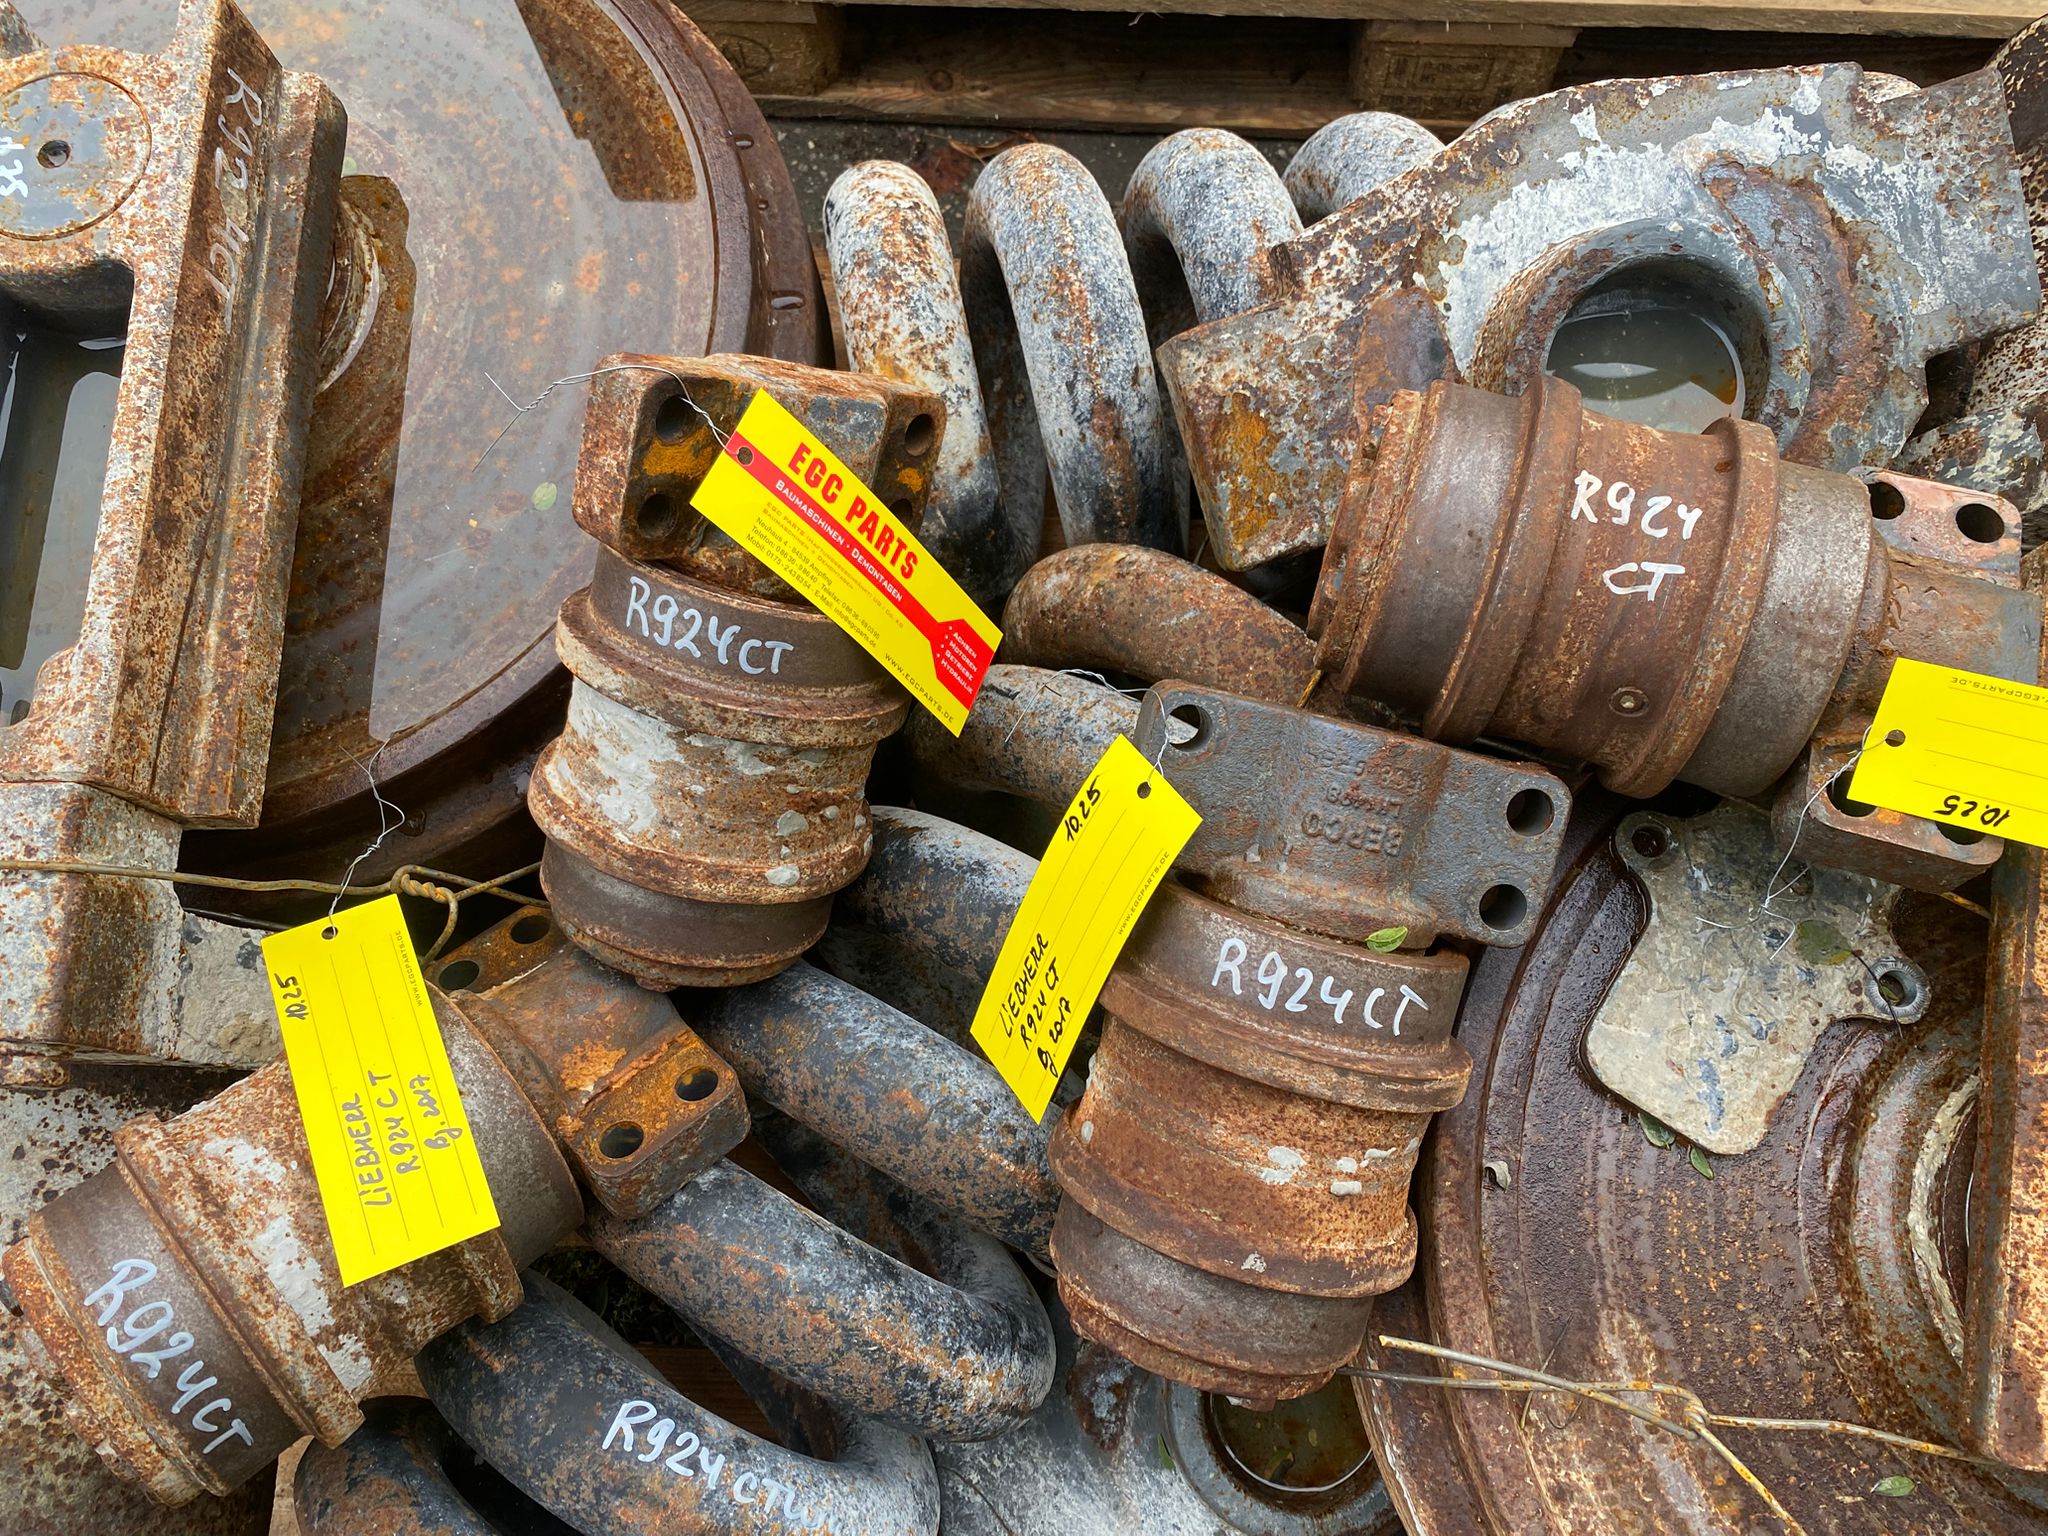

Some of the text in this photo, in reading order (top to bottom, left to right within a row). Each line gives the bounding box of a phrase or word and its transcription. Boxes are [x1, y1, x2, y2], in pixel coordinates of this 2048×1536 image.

[788, 443, 919, 580] EGC PARTS
[1571, 470, 1703, 540] R924
[775, 480, 902, 601] BAUMASCHINEN DEMONTAGEN
[1602, 562, 1686, 602] CT
[884, 654, 953, 722] WWW.EGCPARTS.DE
[949, 641, 976, 671] MOTOREN
[1064, 775, 1104, 842] 10.25
[1933, 795, 2011, 827] 10.25
[1118, 852, 1170, 935] WWW.EGCPARTS.DE
[274, 973, 309, 1021] 10.25
[394, 930, 423, 1008] WWW.EGCPARTS.DE
[1020, 956, 1060, 1051] R924 CT
[1049, 996, 1072, 1042] 2017
[367, 1069, 422, 1176] R924 CT
[409, 1073, 441, 1120] 2017
